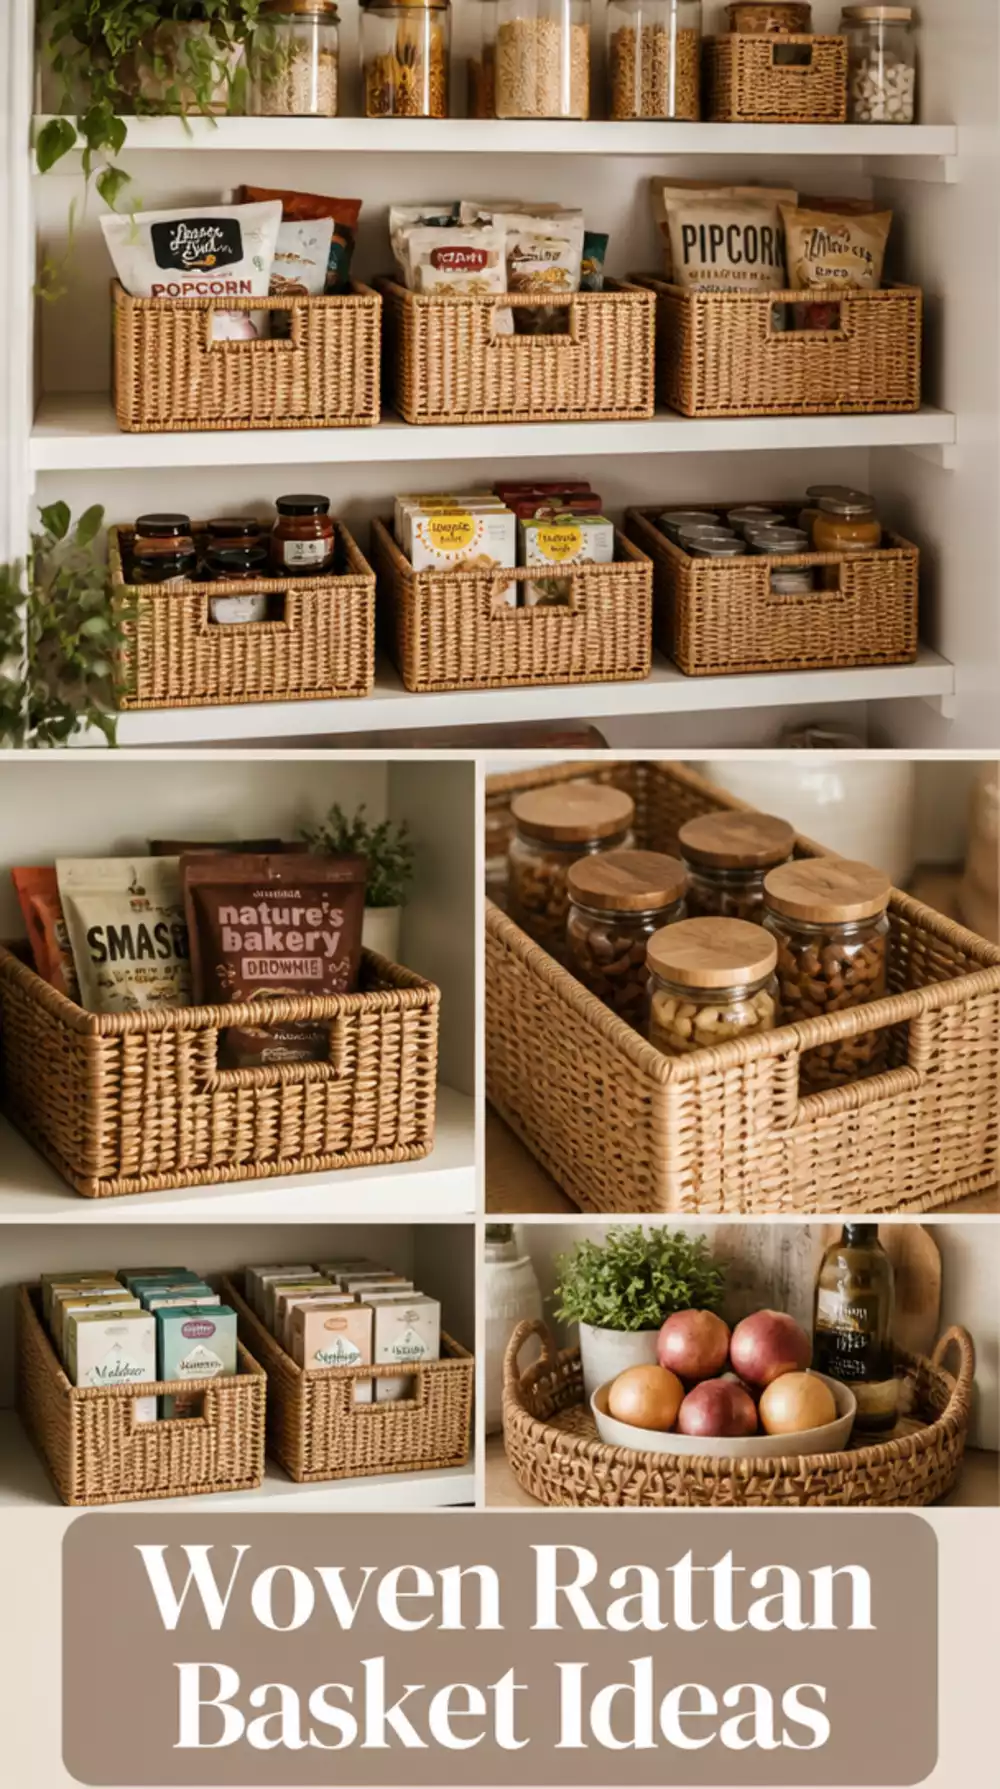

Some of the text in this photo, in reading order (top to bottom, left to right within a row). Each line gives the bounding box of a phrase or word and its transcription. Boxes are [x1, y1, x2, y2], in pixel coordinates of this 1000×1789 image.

[151, 279, 252, 297] POPCORN
[218, 901, 345, 928] nature's
[222, 926, 341, 958] bakery
